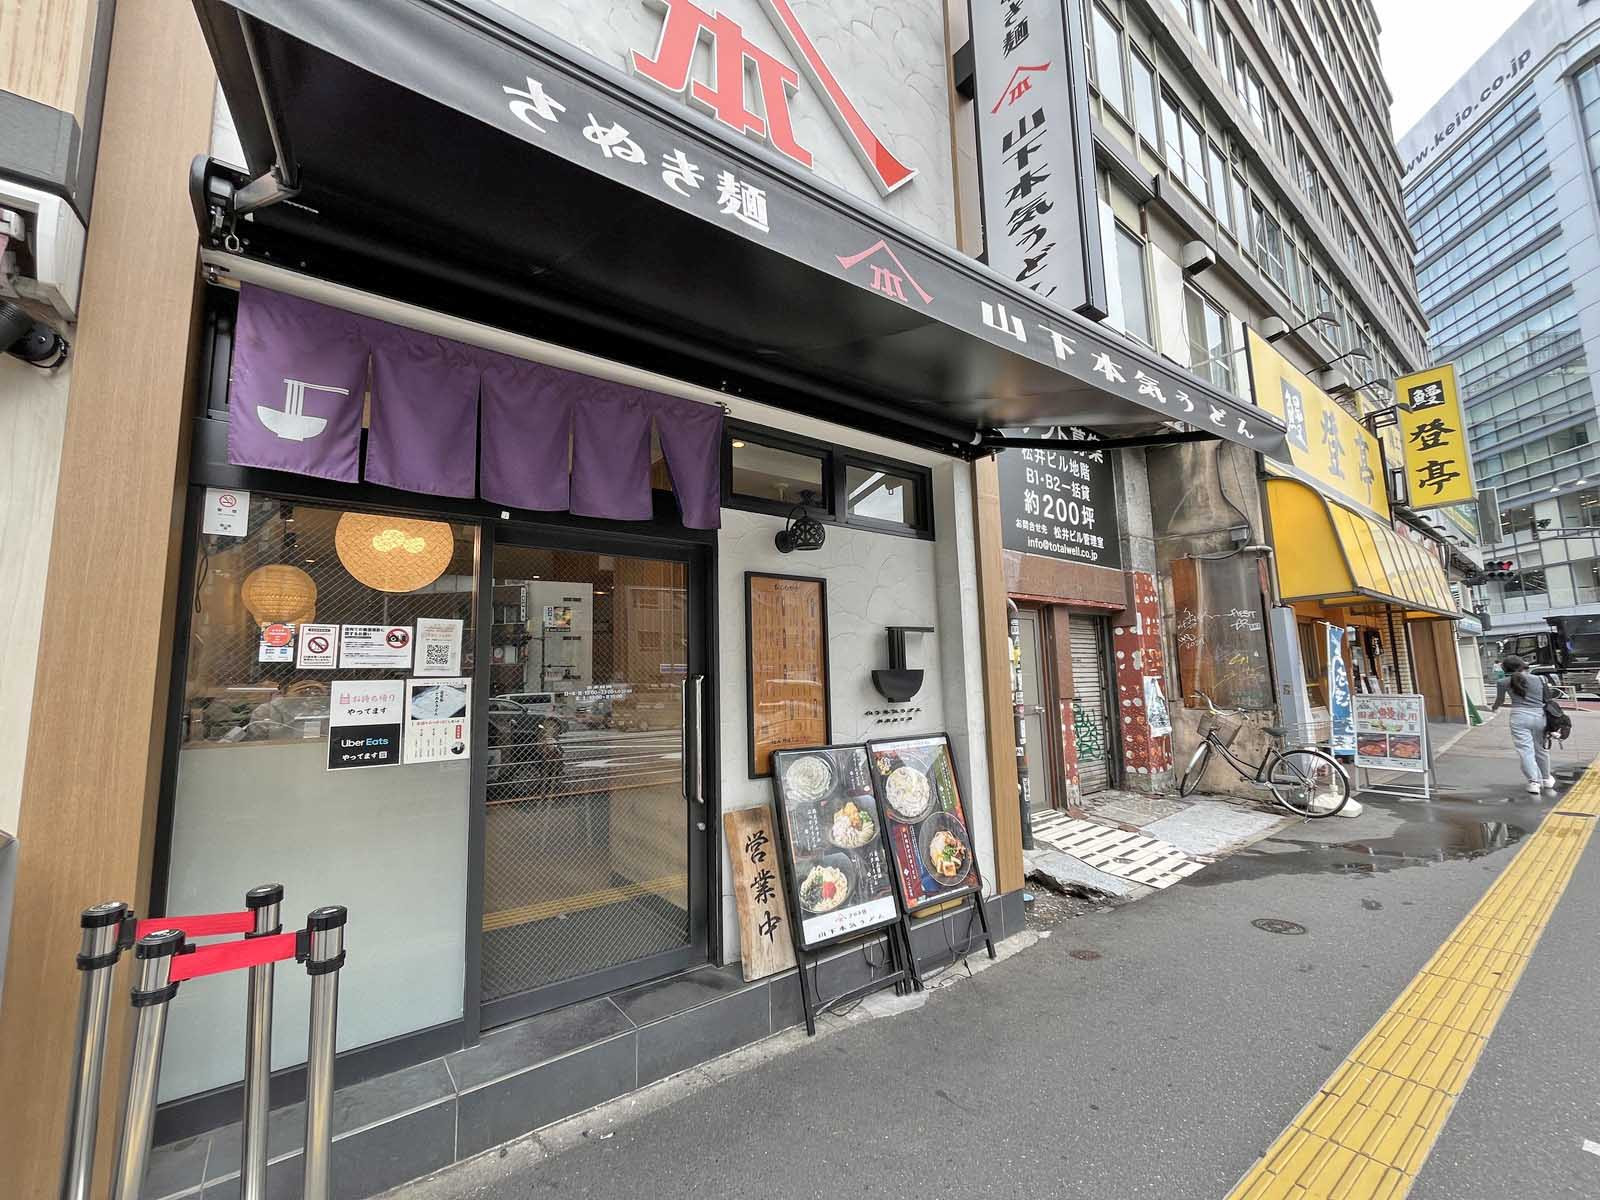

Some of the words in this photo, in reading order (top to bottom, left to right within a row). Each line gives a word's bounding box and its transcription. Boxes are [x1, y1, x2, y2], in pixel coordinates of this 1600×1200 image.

[502, 76, 770, 233] さぬき麺
[981, 301, 1254, 440] 山下本気うどん
[1024, 488, 1096, 530] 約200坪
[347, 707, 387, 716] やってます
[341, 739, 365, 748] Uber
[366, 738, 389, 746] Eats
[342, 752, 378, 761] やってます
[745, 829, 782, 944] 営業中
